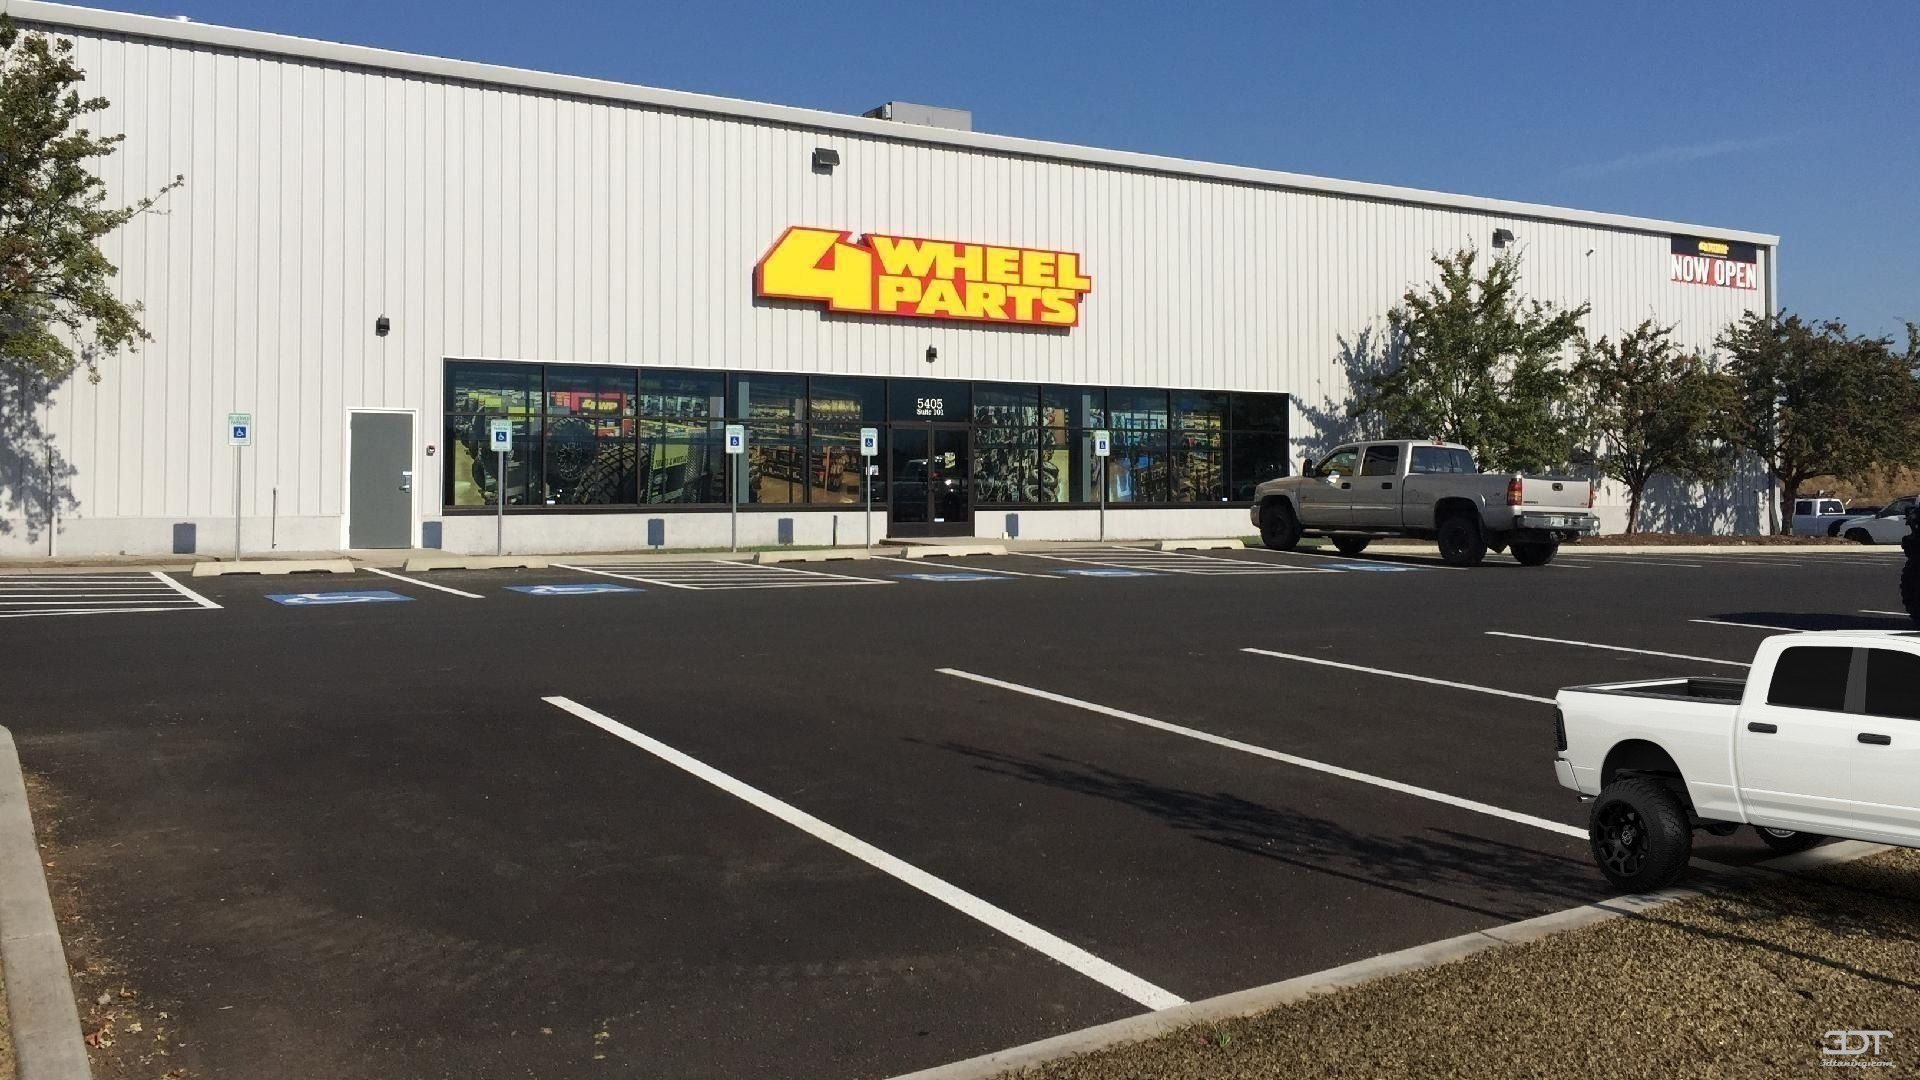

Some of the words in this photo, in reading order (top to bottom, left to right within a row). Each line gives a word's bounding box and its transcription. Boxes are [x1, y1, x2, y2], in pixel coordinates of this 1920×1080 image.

[762, 228, 872, 311] 4
[871, 236, 1091, 293] WHEEL
[1671, 254, 1710, 284] NOW
[1714, 259, 1757, 289] OPEN
[878, 275, 1077, 324] PARTS
[917, 398, 943, 409] 5405
